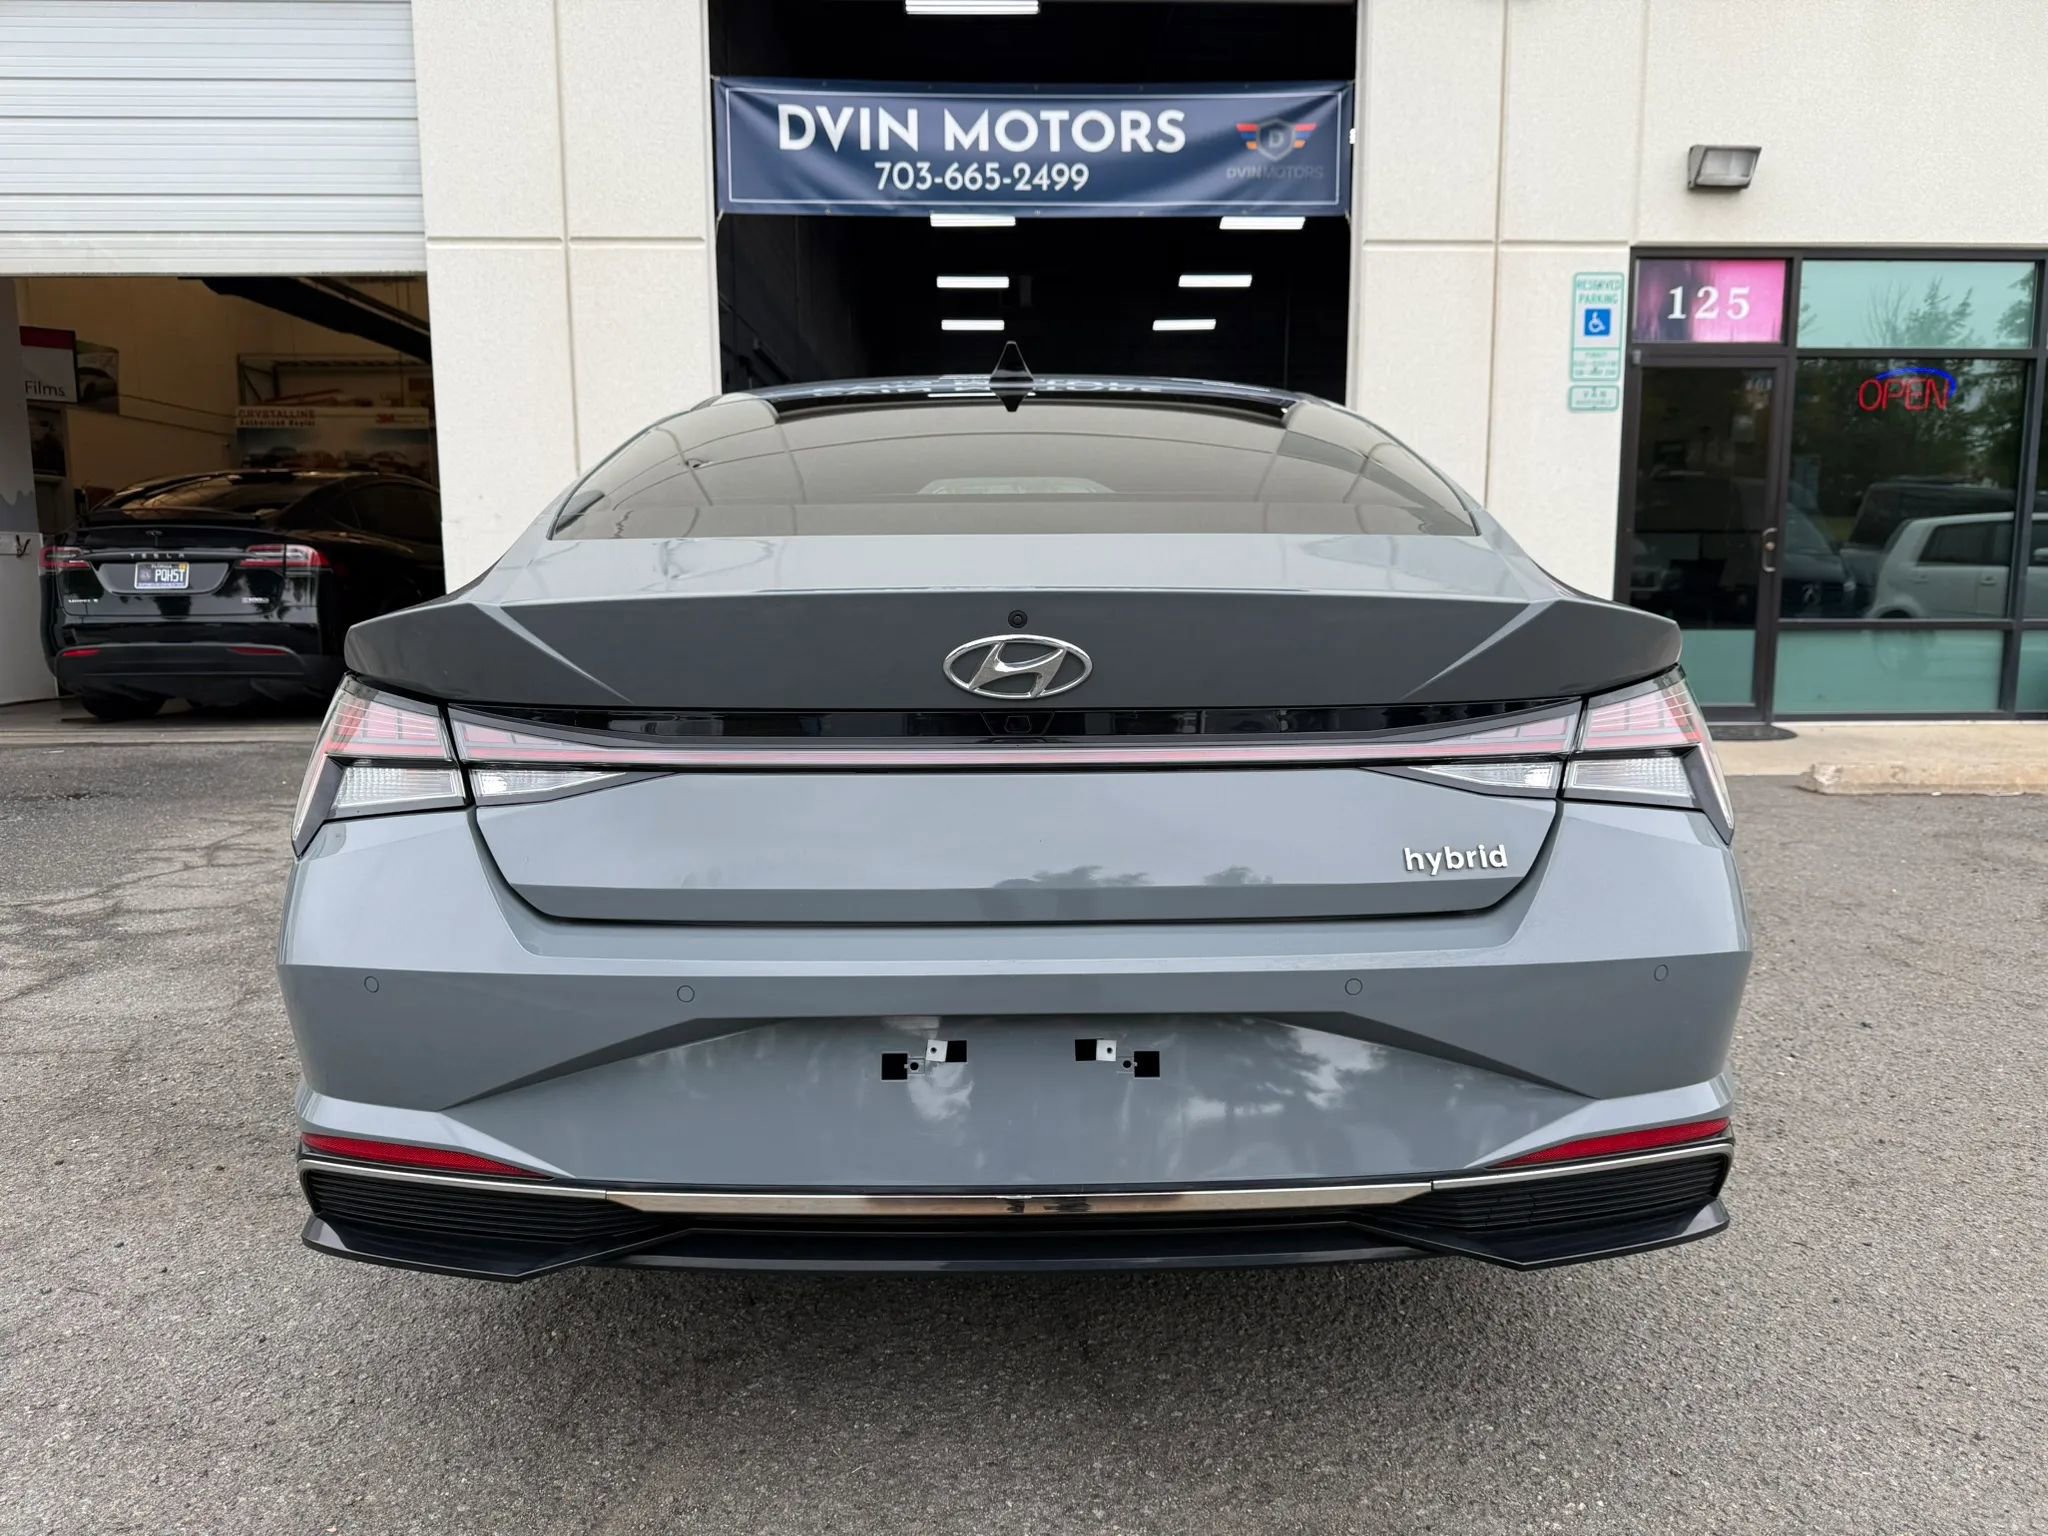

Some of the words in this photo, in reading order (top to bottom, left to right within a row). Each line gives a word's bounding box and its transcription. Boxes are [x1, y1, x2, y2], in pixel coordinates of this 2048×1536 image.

[778, 104, 919, 152] DVIN
[944, 108, 1186, 153] MOTORS
[874, 161, 1090, 191] 703-665-2499
[1579, 293, 1618, 304] PARKING
[1667, 286, 1750, 320] 125
[25, 380, 65, 396] Films
[1858, 378, 1949, 412] OPEN
[1403, 844, 1508, 876] hybrid
